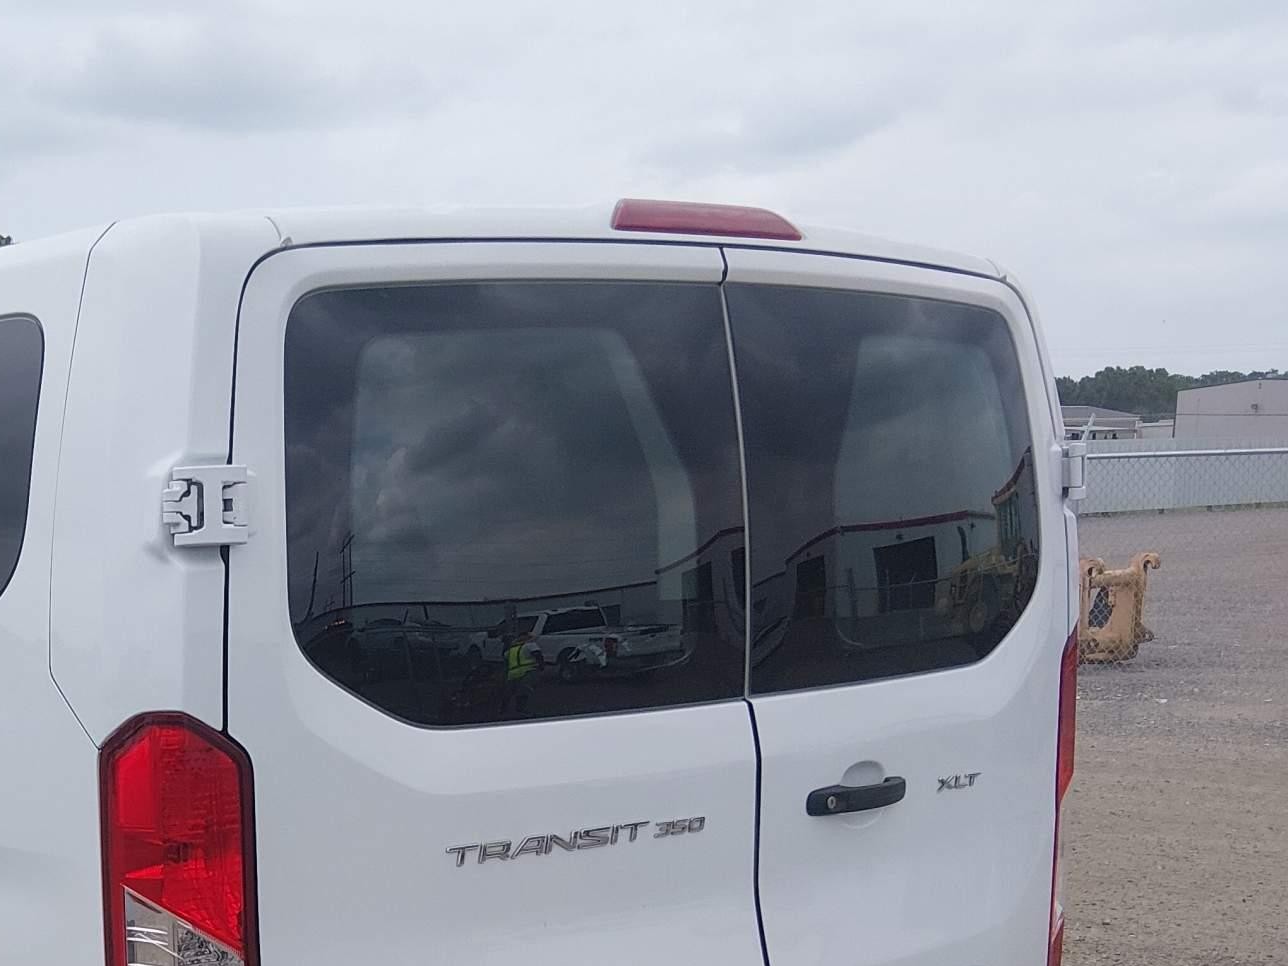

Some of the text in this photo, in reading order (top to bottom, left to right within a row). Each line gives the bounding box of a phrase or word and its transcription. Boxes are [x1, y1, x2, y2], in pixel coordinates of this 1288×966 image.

[936, 773, 981, 793] XLT
[445, 816, 706, 867] TRANSIT 350
